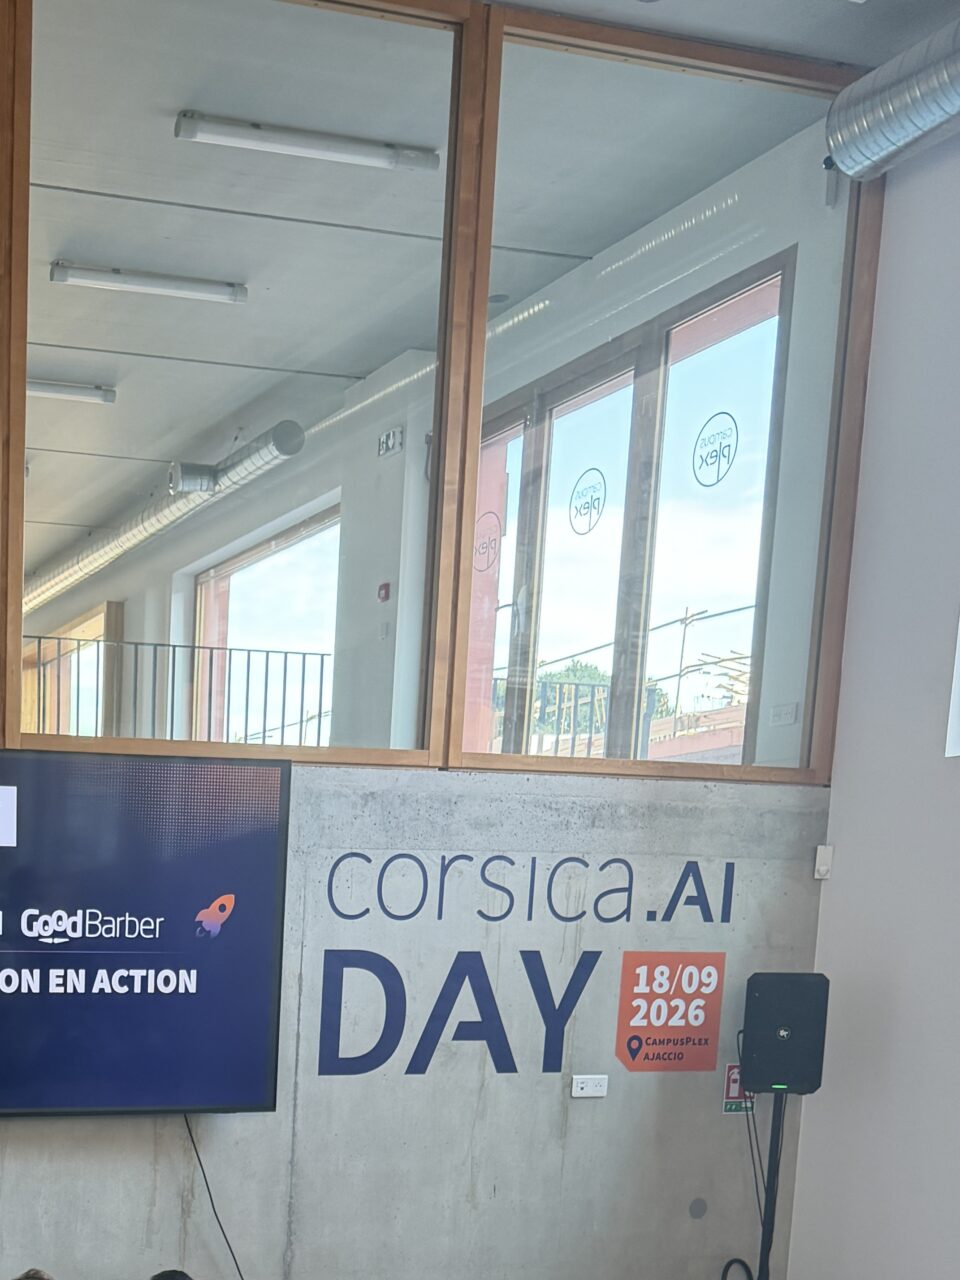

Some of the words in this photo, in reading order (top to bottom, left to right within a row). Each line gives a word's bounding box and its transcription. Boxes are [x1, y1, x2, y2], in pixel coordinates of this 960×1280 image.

[327, 852, 735, 923] corsica.AI
[20, 908, 164, 943] GoodBarber
[49, 969, 86, 994] EN
[92, 969, 197, 994] ACTION
[633, 963, 718, 997] 18/09
[317, 949, 602, 1076] DAY
[629, 997, 706, 1027] 2026
[643, 1051, 684, 1062] AJACCIO
